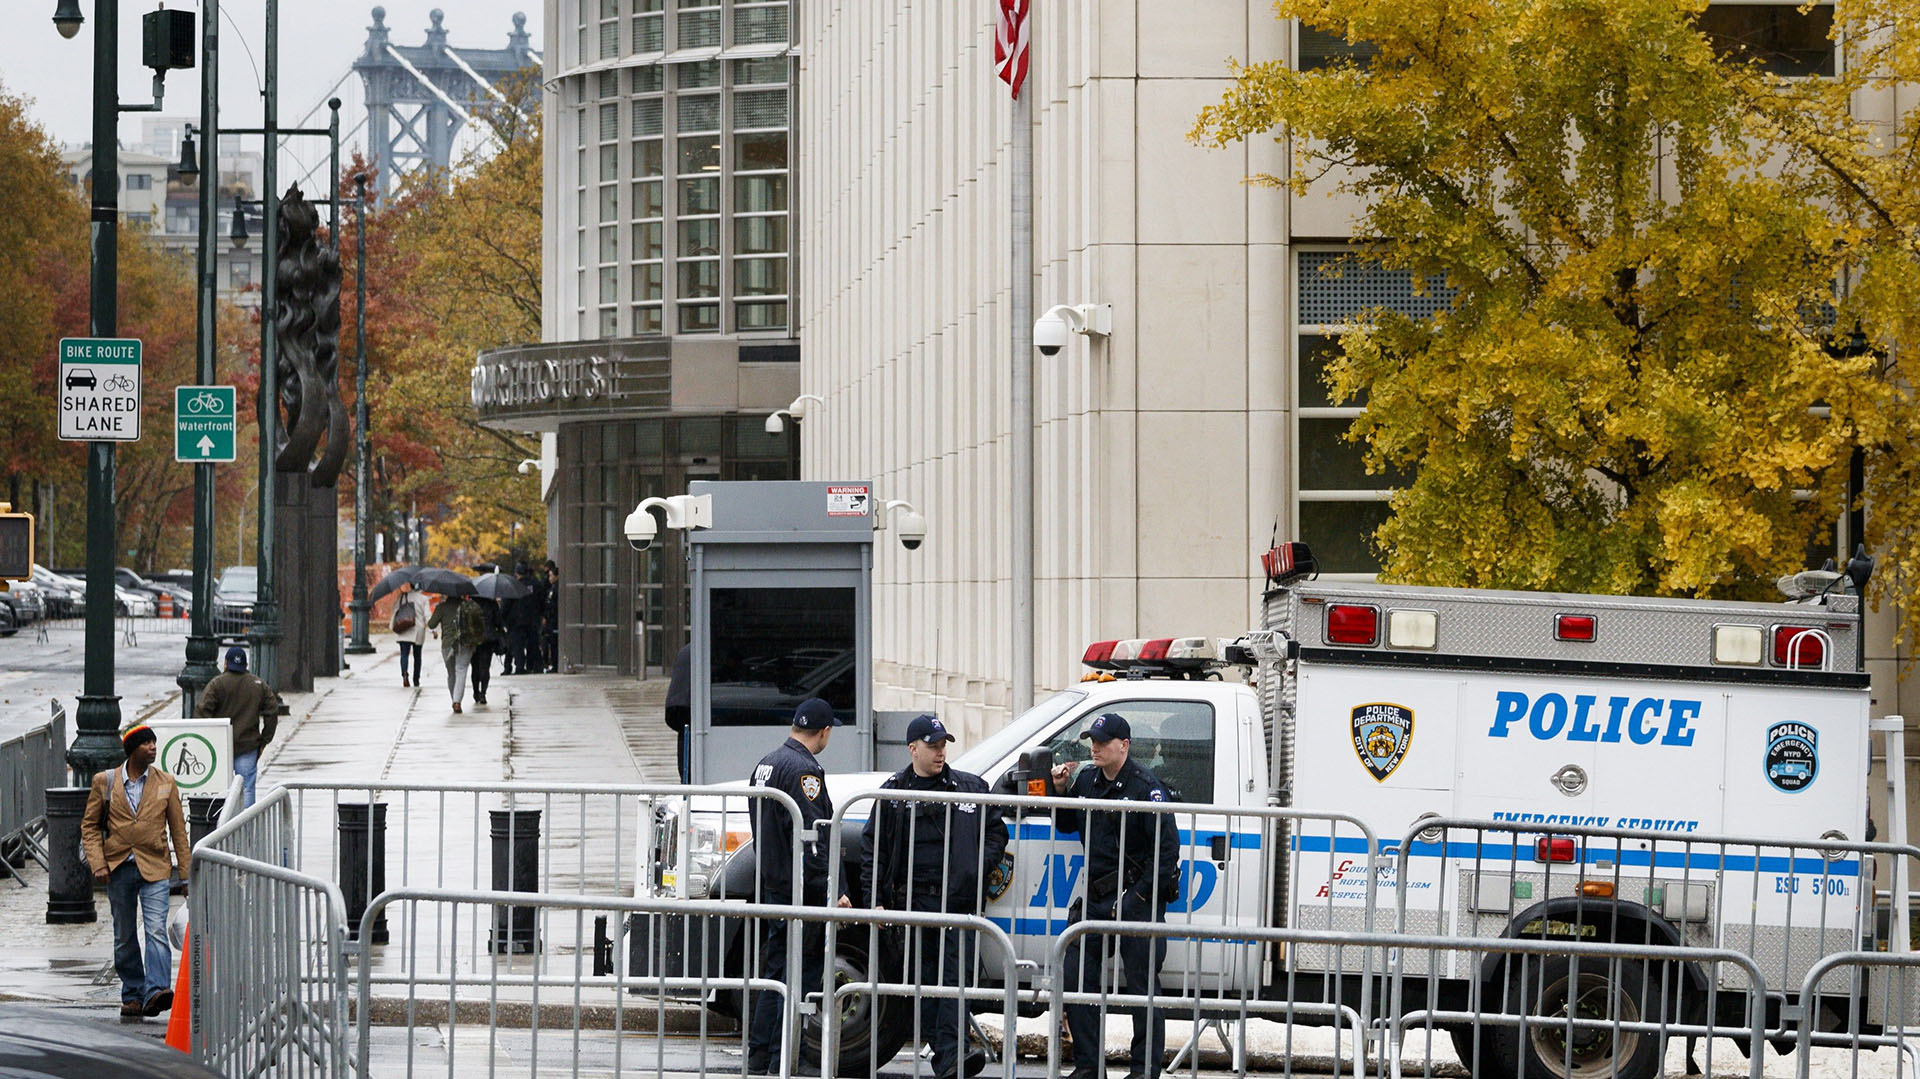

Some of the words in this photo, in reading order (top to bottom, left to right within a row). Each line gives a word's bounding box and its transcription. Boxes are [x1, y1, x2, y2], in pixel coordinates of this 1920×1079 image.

[67, 346, 92, 358] BIKE
[97, 346, 134, 358] ROUTE
[63, 396, 136, 412] SHARED
[76, 416, 122, 431] LANE
[179, 421, 233, 431] Waterfront
[1366, 705, 1399, 717] POLICE
[1488, 691, 1702, 747] POLICE
[1354, 714, 1410, 729] DEPARTMENT
[1770, 724, 1815, 745] POLICE
[1354, 736, 1366, 756] CITY
[1363, 757, 1374, 768] OF
[1385, 756, 1399, 773] NEW
[1397, 733, 1410, 754] YORK
[1771, 740, 1813, 757] EMERGENCY
[754, 764, 773, 780] NYPD
[1775, 877, 1800, 894] ESU
